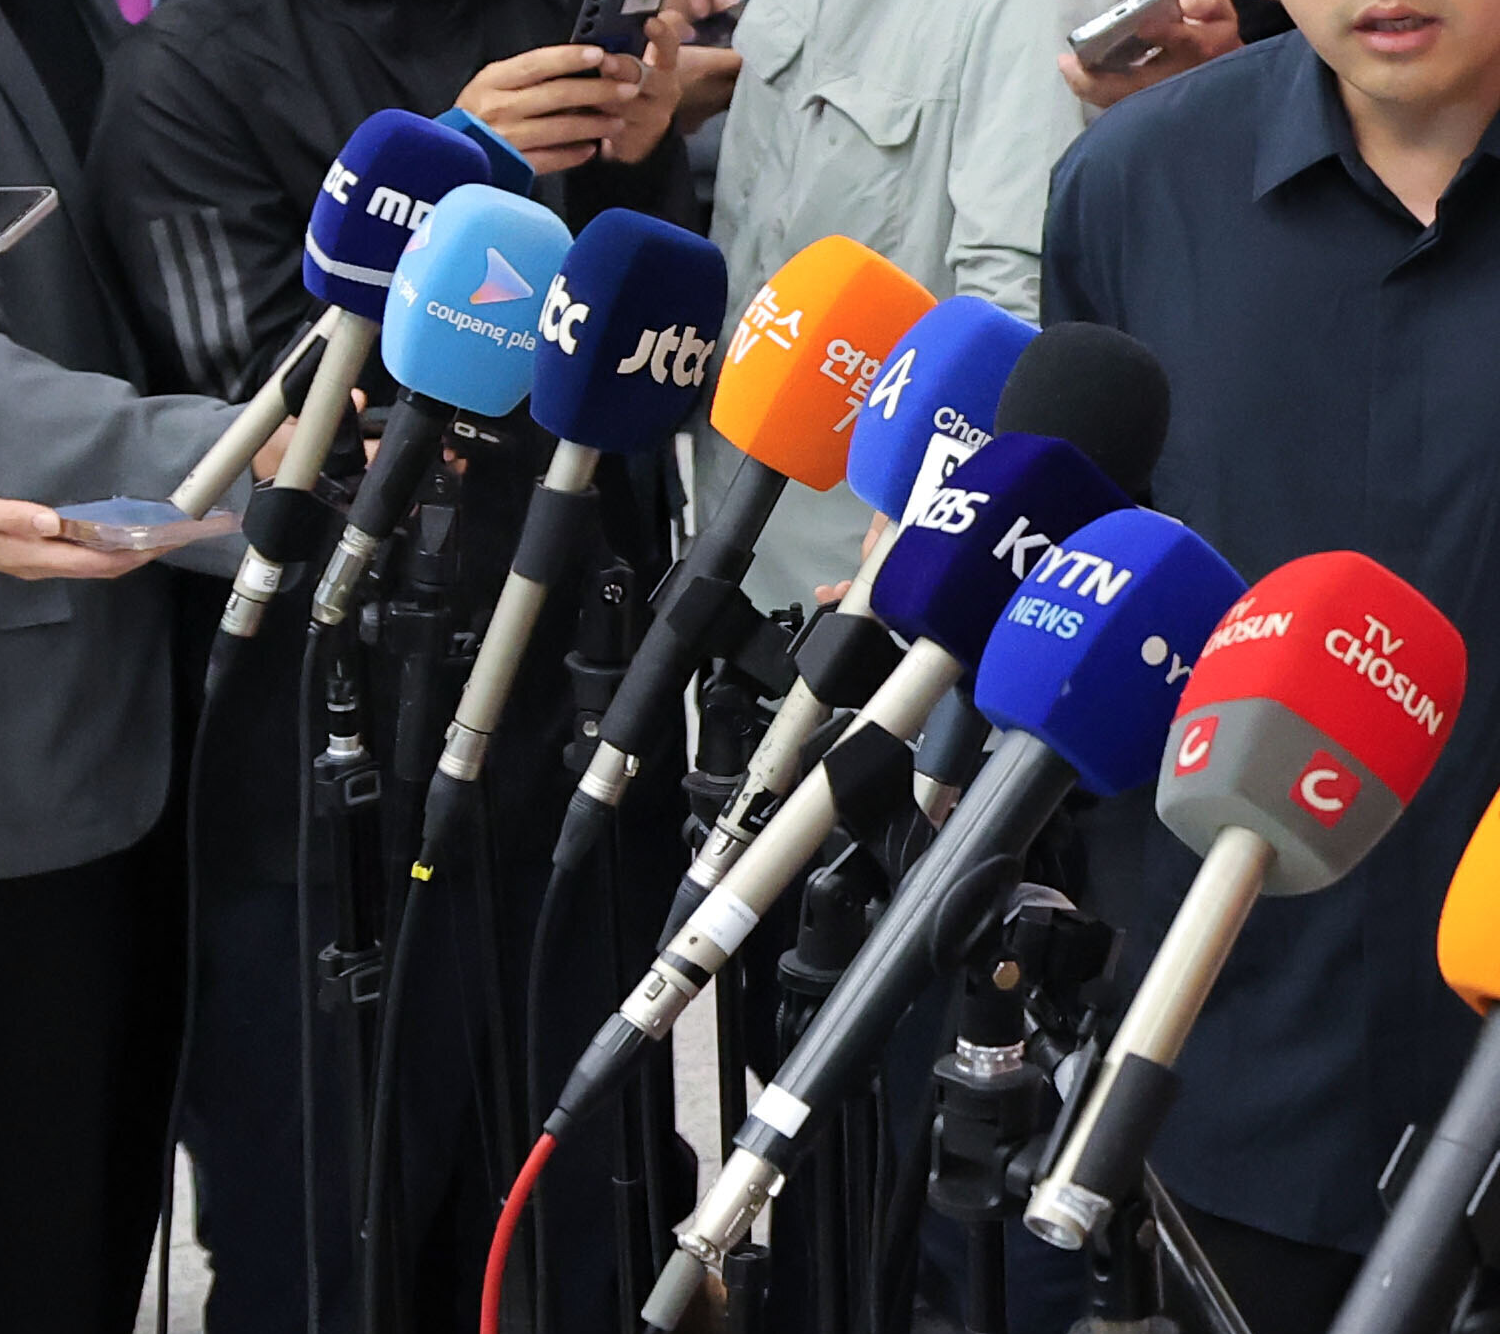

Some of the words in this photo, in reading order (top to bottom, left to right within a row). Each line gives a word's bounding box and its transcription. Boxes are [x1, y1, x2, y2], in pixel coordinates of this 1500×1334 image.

[426, 301, 508, 346] coupang
[506, 331, 537, 351] pla
[1036, 544, 1133, 606] YTN
[1007, 595, 1084, 640] NEWS
[1364, 614, 1404, 656] TV
[1324, 628, 1444, 736] CHOSUN
